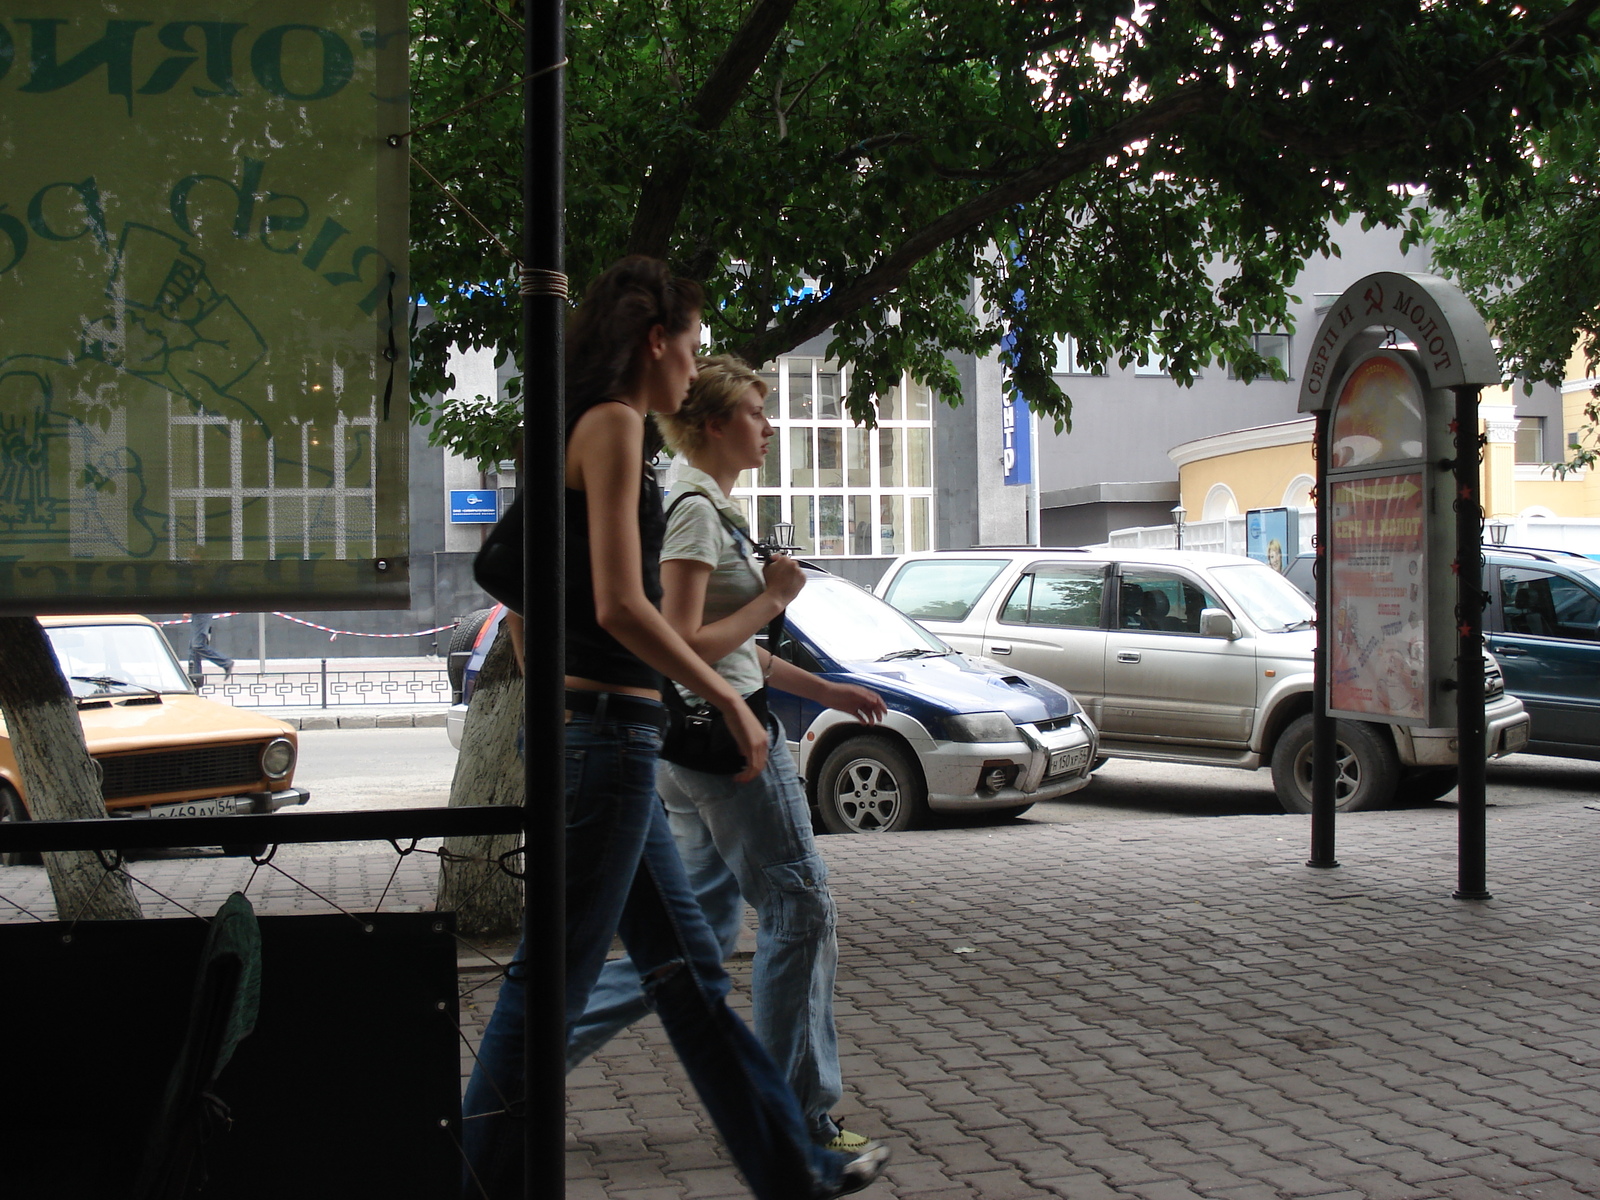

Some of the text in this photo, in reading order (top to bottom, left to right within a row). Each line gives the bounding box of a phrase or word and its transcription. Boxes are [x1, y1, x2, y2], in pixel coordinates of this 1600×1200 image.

[1308, 290, 1452, 394] СЕРП И МОЛОТ
[158, 799, 233, 818] 469АУ 54
